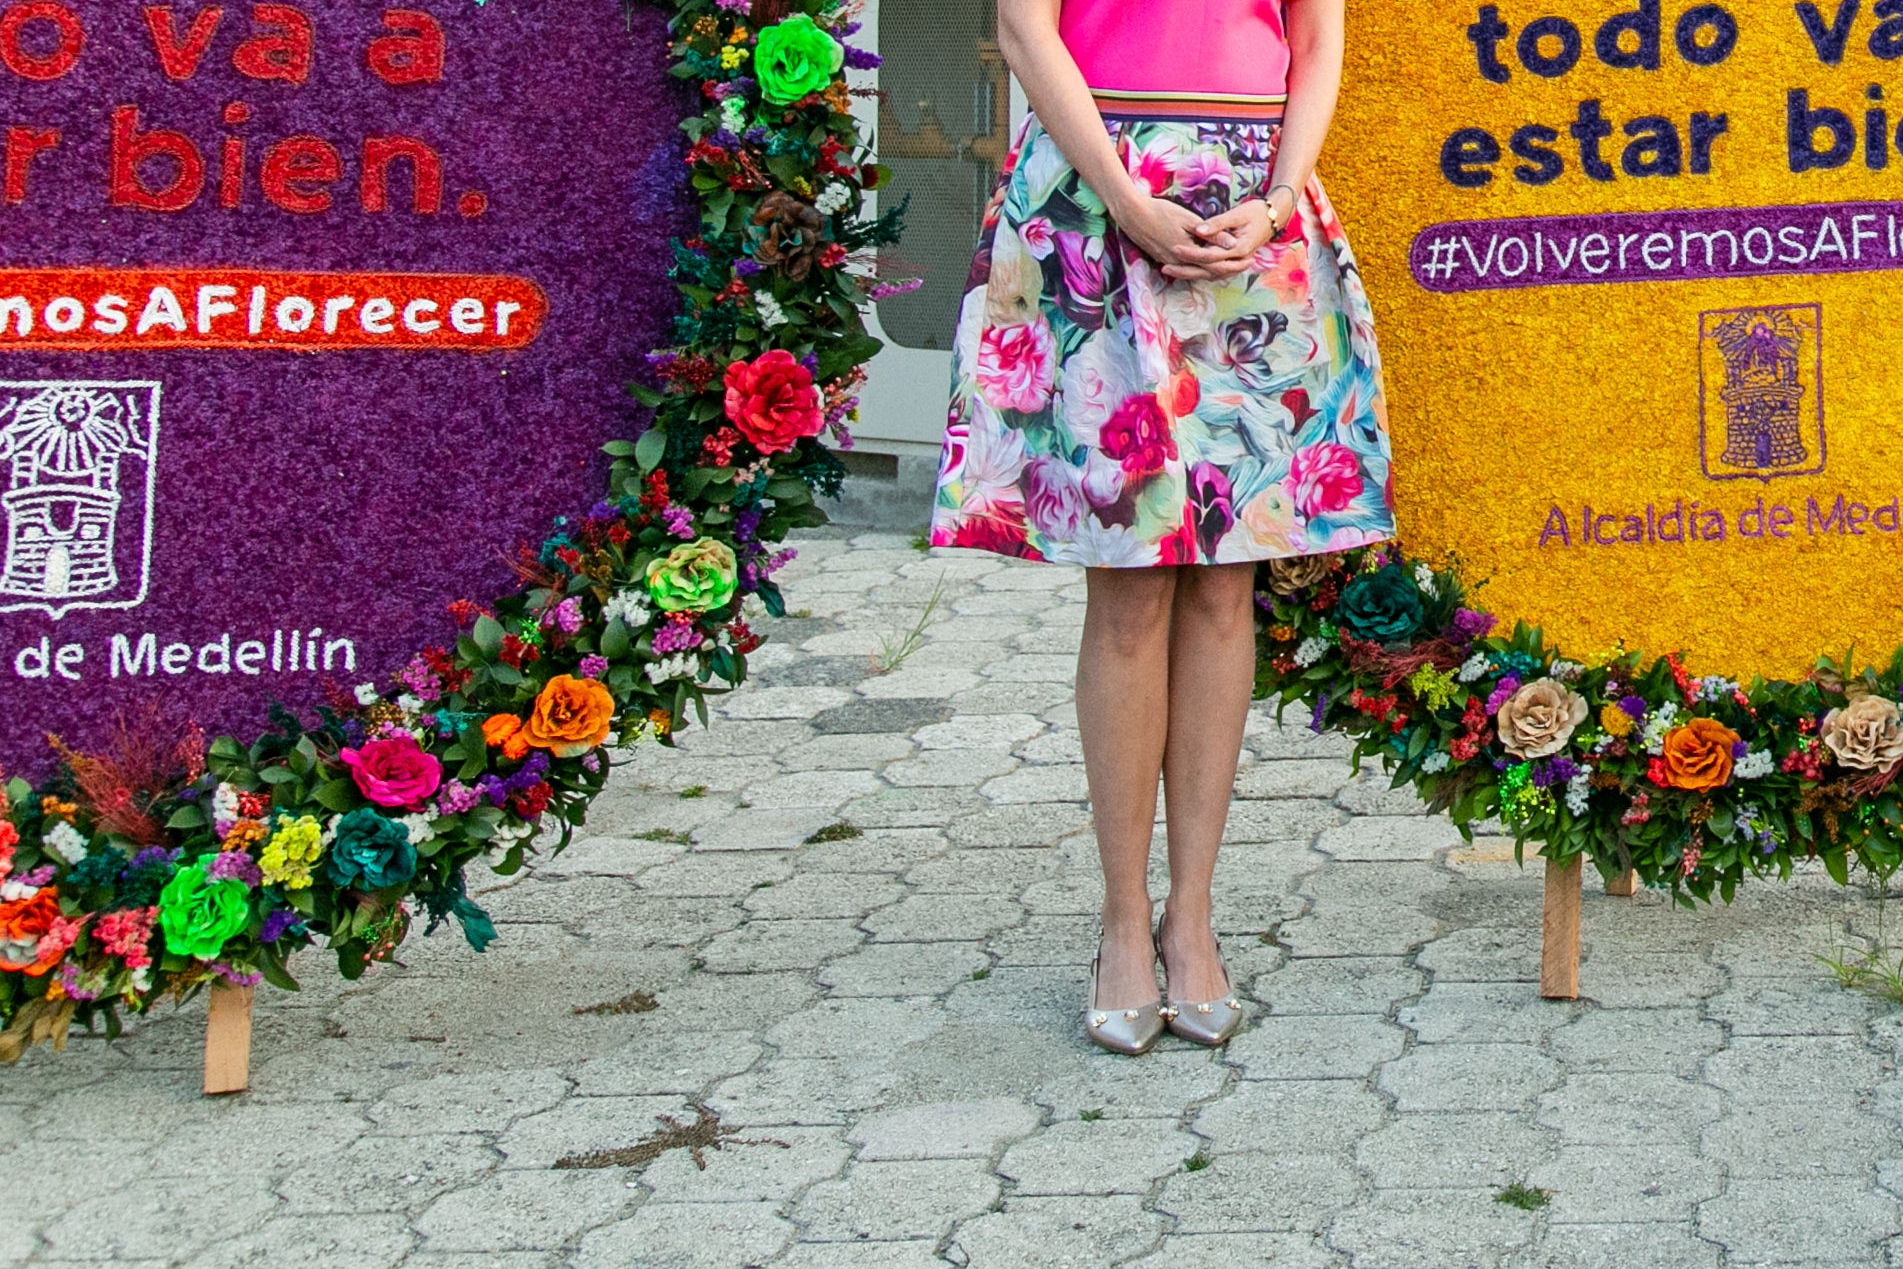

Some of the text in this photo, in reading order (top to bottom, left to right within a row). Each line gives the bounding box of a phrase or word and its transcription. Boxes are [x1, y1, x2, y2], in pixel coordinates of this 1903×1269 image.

[142, 3, 313, 86] va
[366, 8, 446, 86] a
[109, 103, 489, 219] bien.
[1439, 97, 1729, 189] estar
[1537, 498, 1729, 548] Alcaldía
[1738, 494, 1794, 540] de
[13, 627, 356, 680] de Medellín
